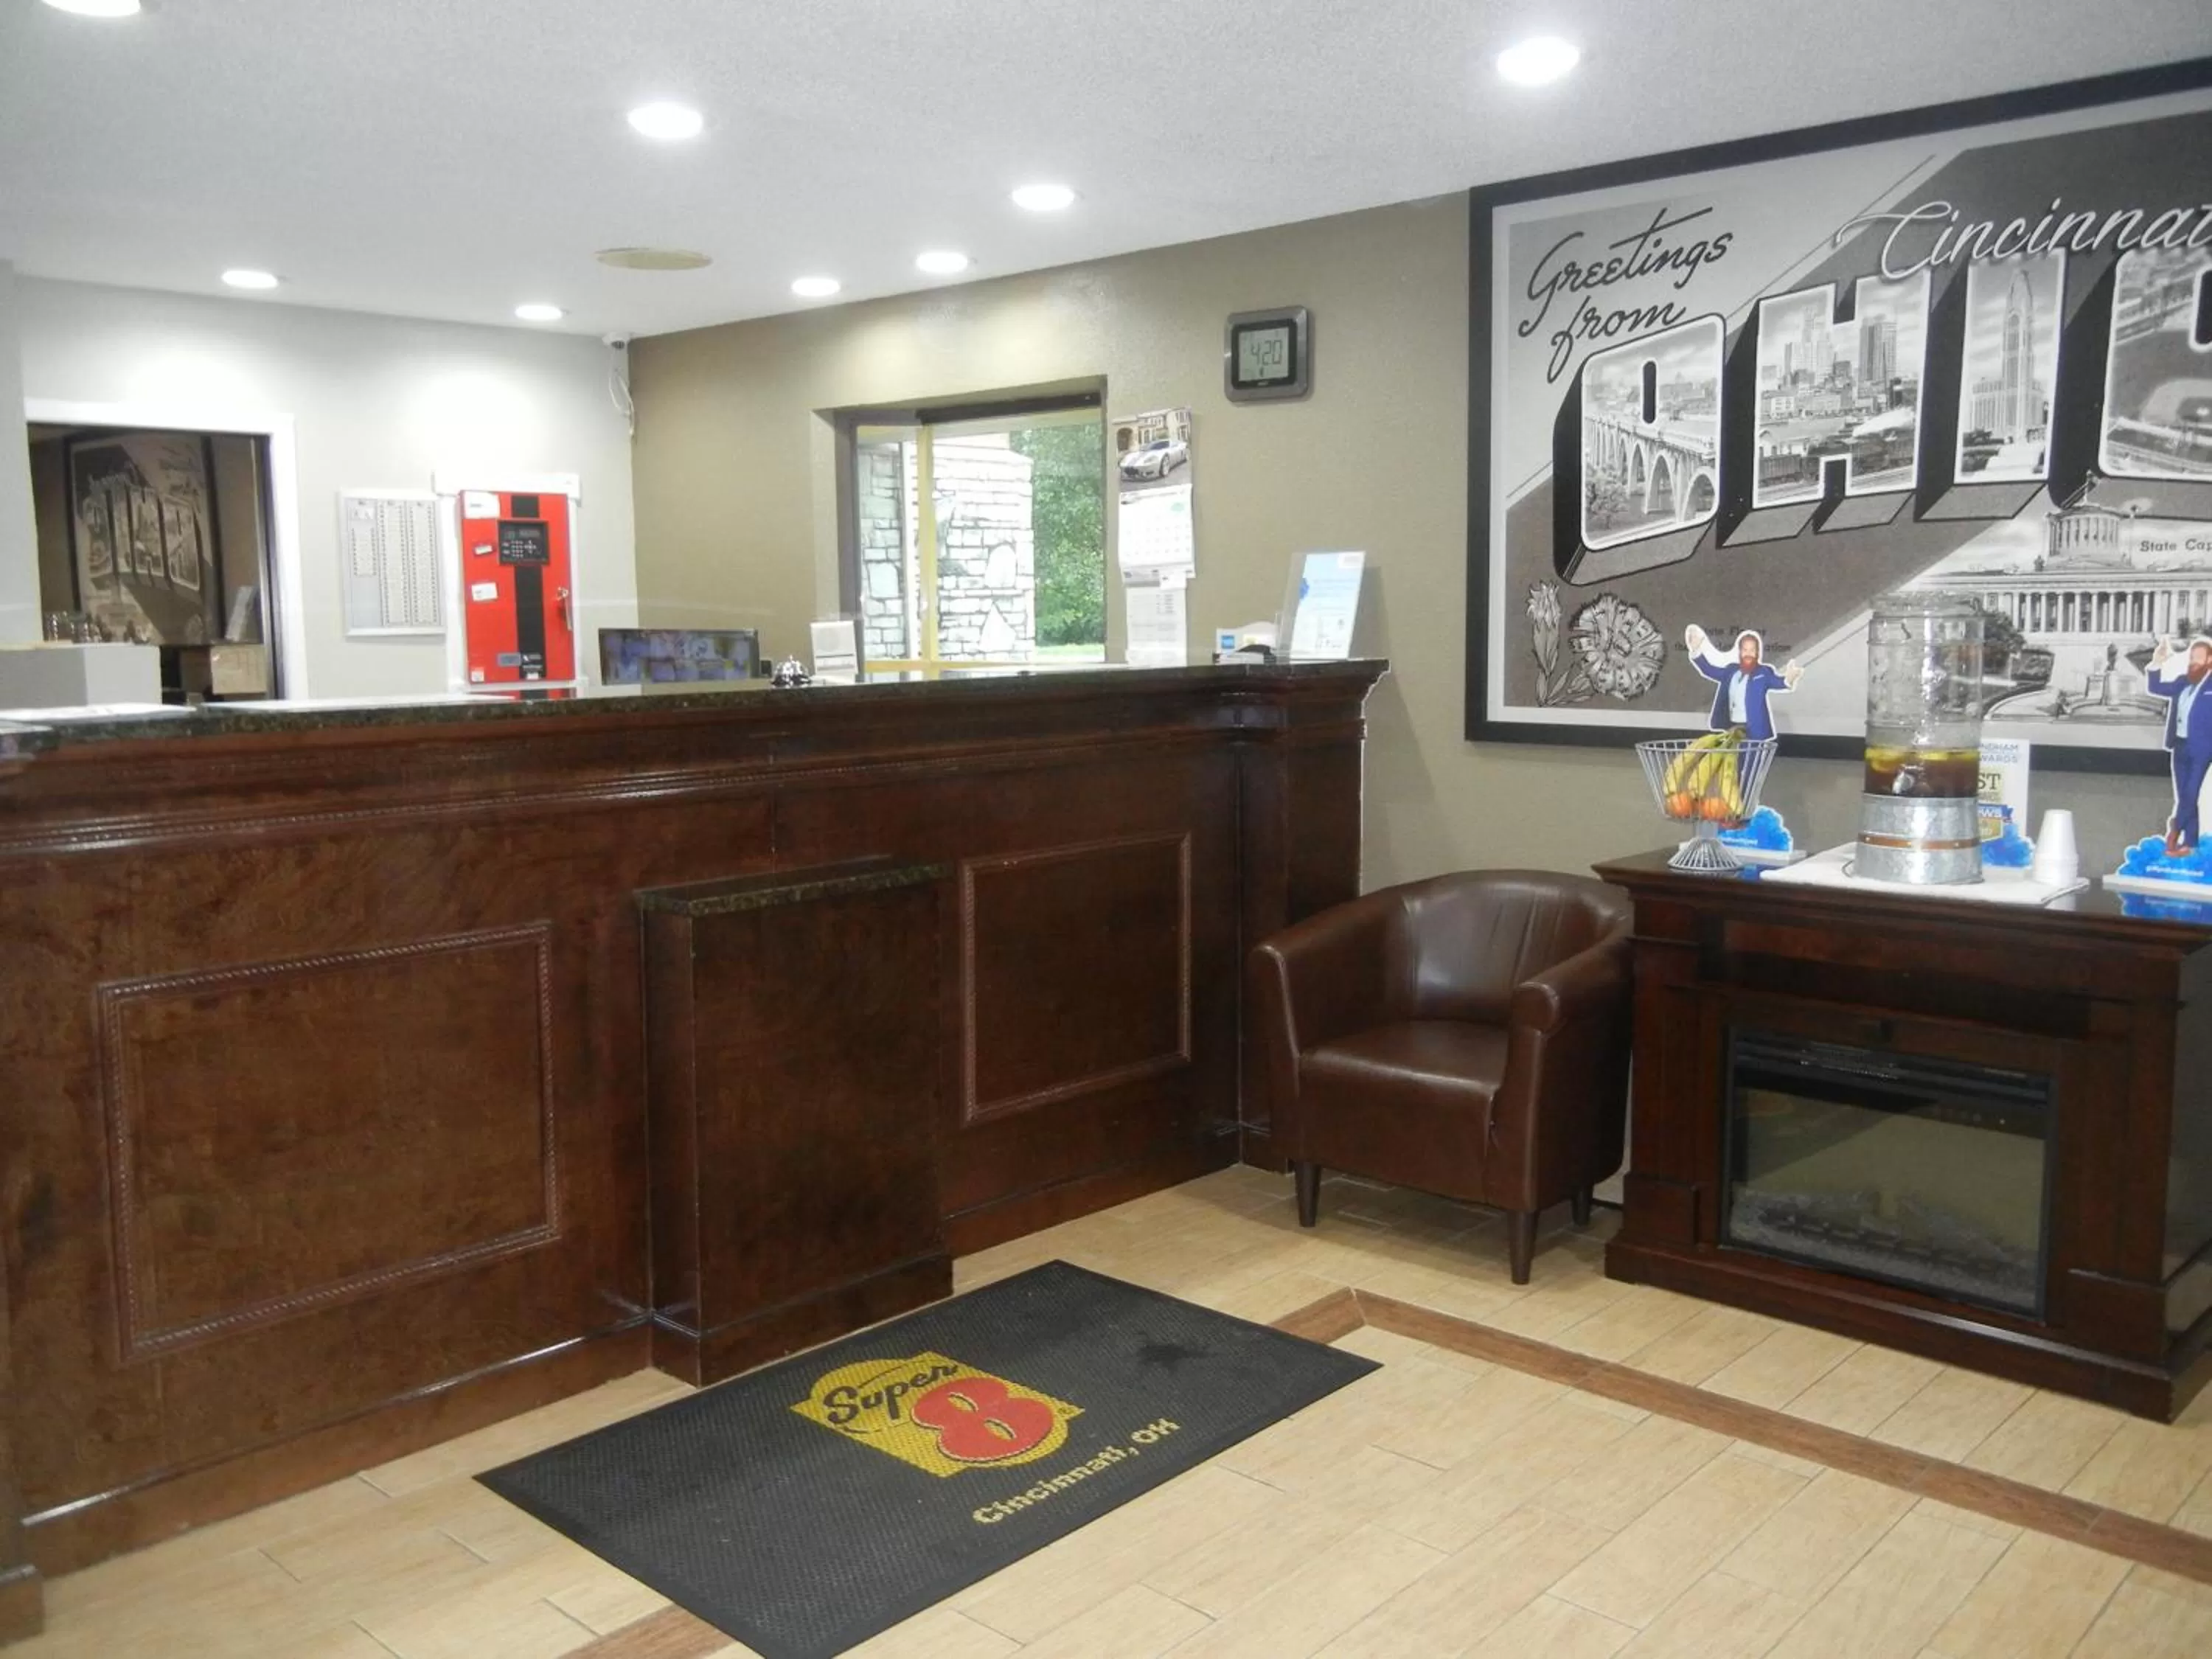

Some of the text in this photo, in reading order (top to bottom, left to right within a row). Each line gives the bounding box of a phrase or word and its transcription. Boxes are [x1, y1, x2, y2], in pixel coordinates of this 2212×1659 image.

[1517, 206, 1733, 338] Greetings
[1547, 295, 1687, 383] from
[2140, 539, 2178, 553] State
[1978, 773, 2001, 790] ST
[823, 1364, 1055, 1463] Super 8
[972, 1417, 1180, 1524] Cincinnati, OH
